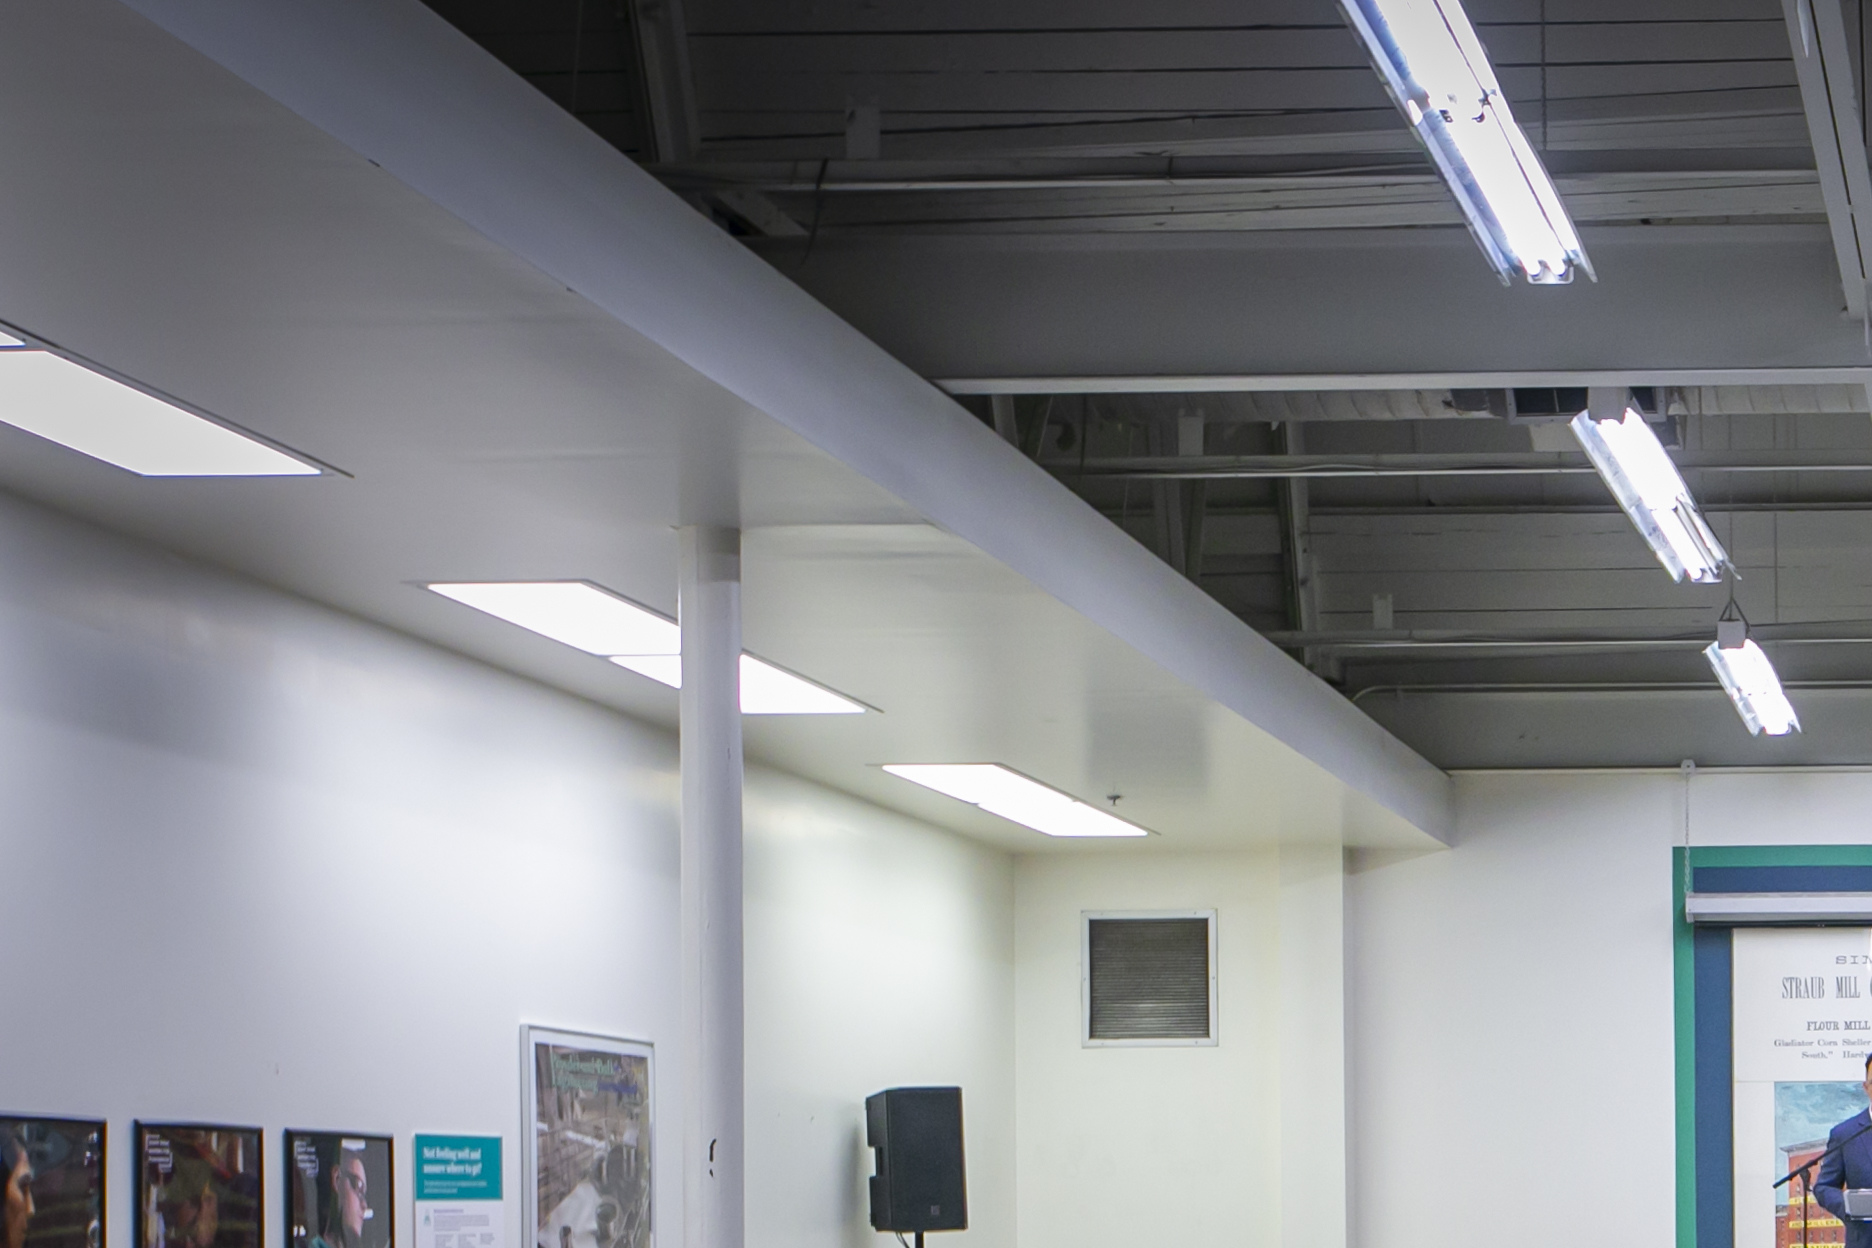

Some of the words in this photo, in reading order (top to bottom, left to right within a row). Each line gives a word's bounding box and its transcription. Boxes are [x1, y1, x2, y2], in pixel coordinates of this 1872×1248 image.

[1782, 976, 1825, 999] STRAUB
[1835, 976, 1861, 999] MILL
[1806, 1021, 1840, 1031] FLOUR
[1844, 1020, 1871, 1030] MILL
[1774, 1038, 1815, 1047] Gladiator
[1817, 1038, 1838, 1047] Corn
[1842, 1037, 1872, 1047] Sheller
